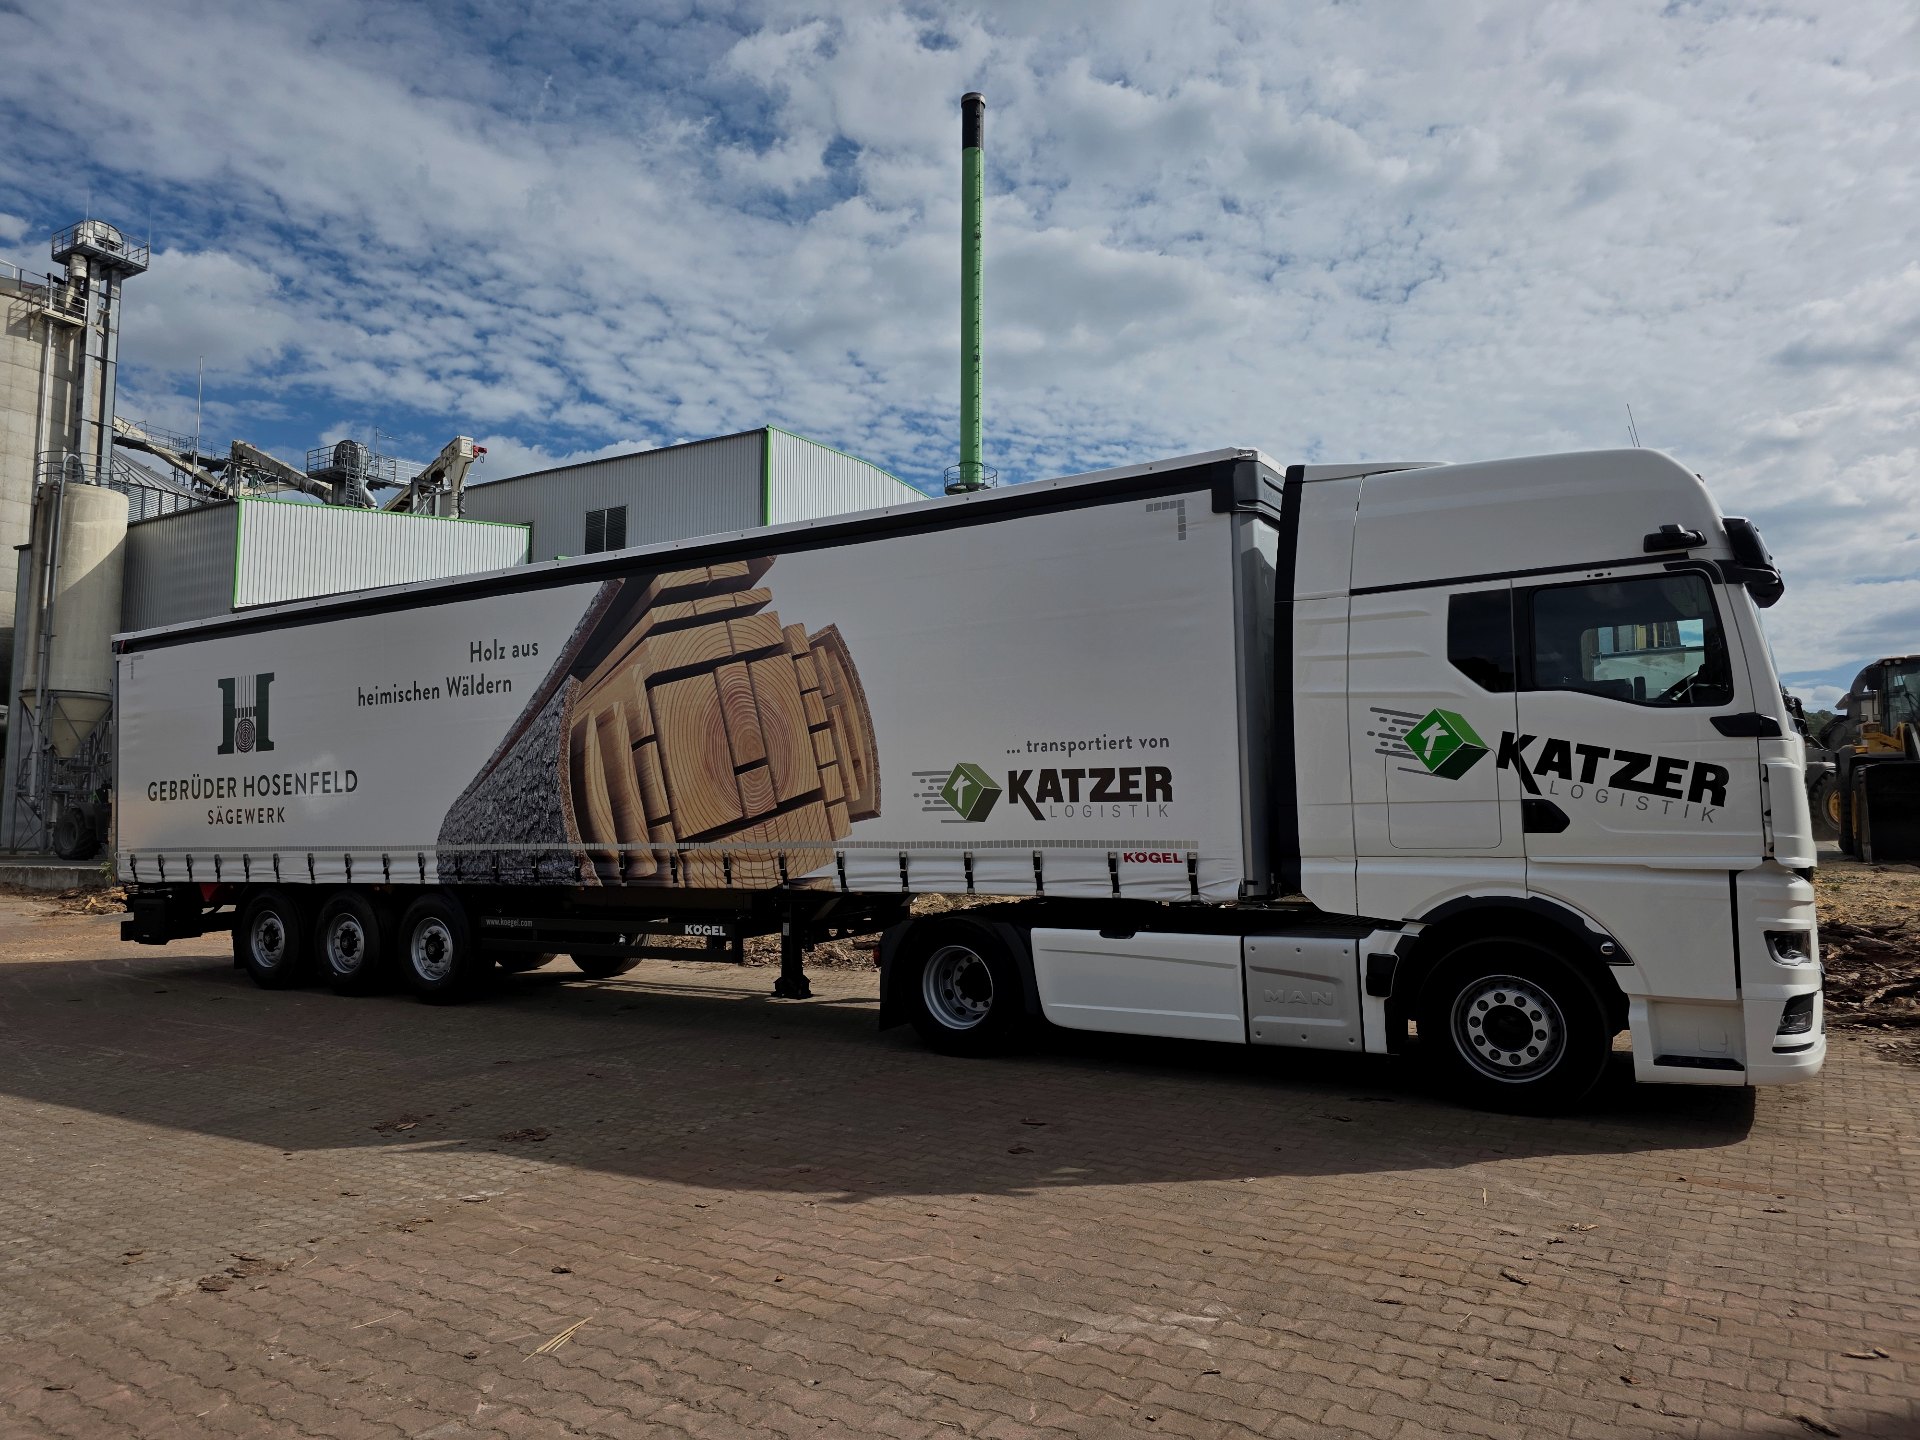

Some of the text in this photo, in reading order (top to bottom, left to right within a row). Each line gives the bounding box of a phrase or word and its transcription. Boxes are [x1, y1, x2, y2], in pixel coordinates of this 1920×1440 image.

[470, 638, 539, 663] Holz aus
[357, 673, 512, 707] heimischen Wäldern
[1026, 734, 1133, 758] transportiert
[1138, 736, 1170, 749] von
[1496, 730, 1730, 807] KATZER
[147, 769, 358, 802] GEBRÜDER HOSENFELD
[1007, 766, 1173, 821] KATZER
[1049, 804, 1169, 818] LOGISTIK
[1549, 780, 1716, 824] LOGISTIK
[207, 806, 286, 825] SÄGEWERK
[1123, 851, 1183, 864] KÖGEL
[486, 918, 533, 927] www.koegel.com
[684, 924, 726, 936] KÖGEL
[1264, 989, 1334, 1006] MAN
